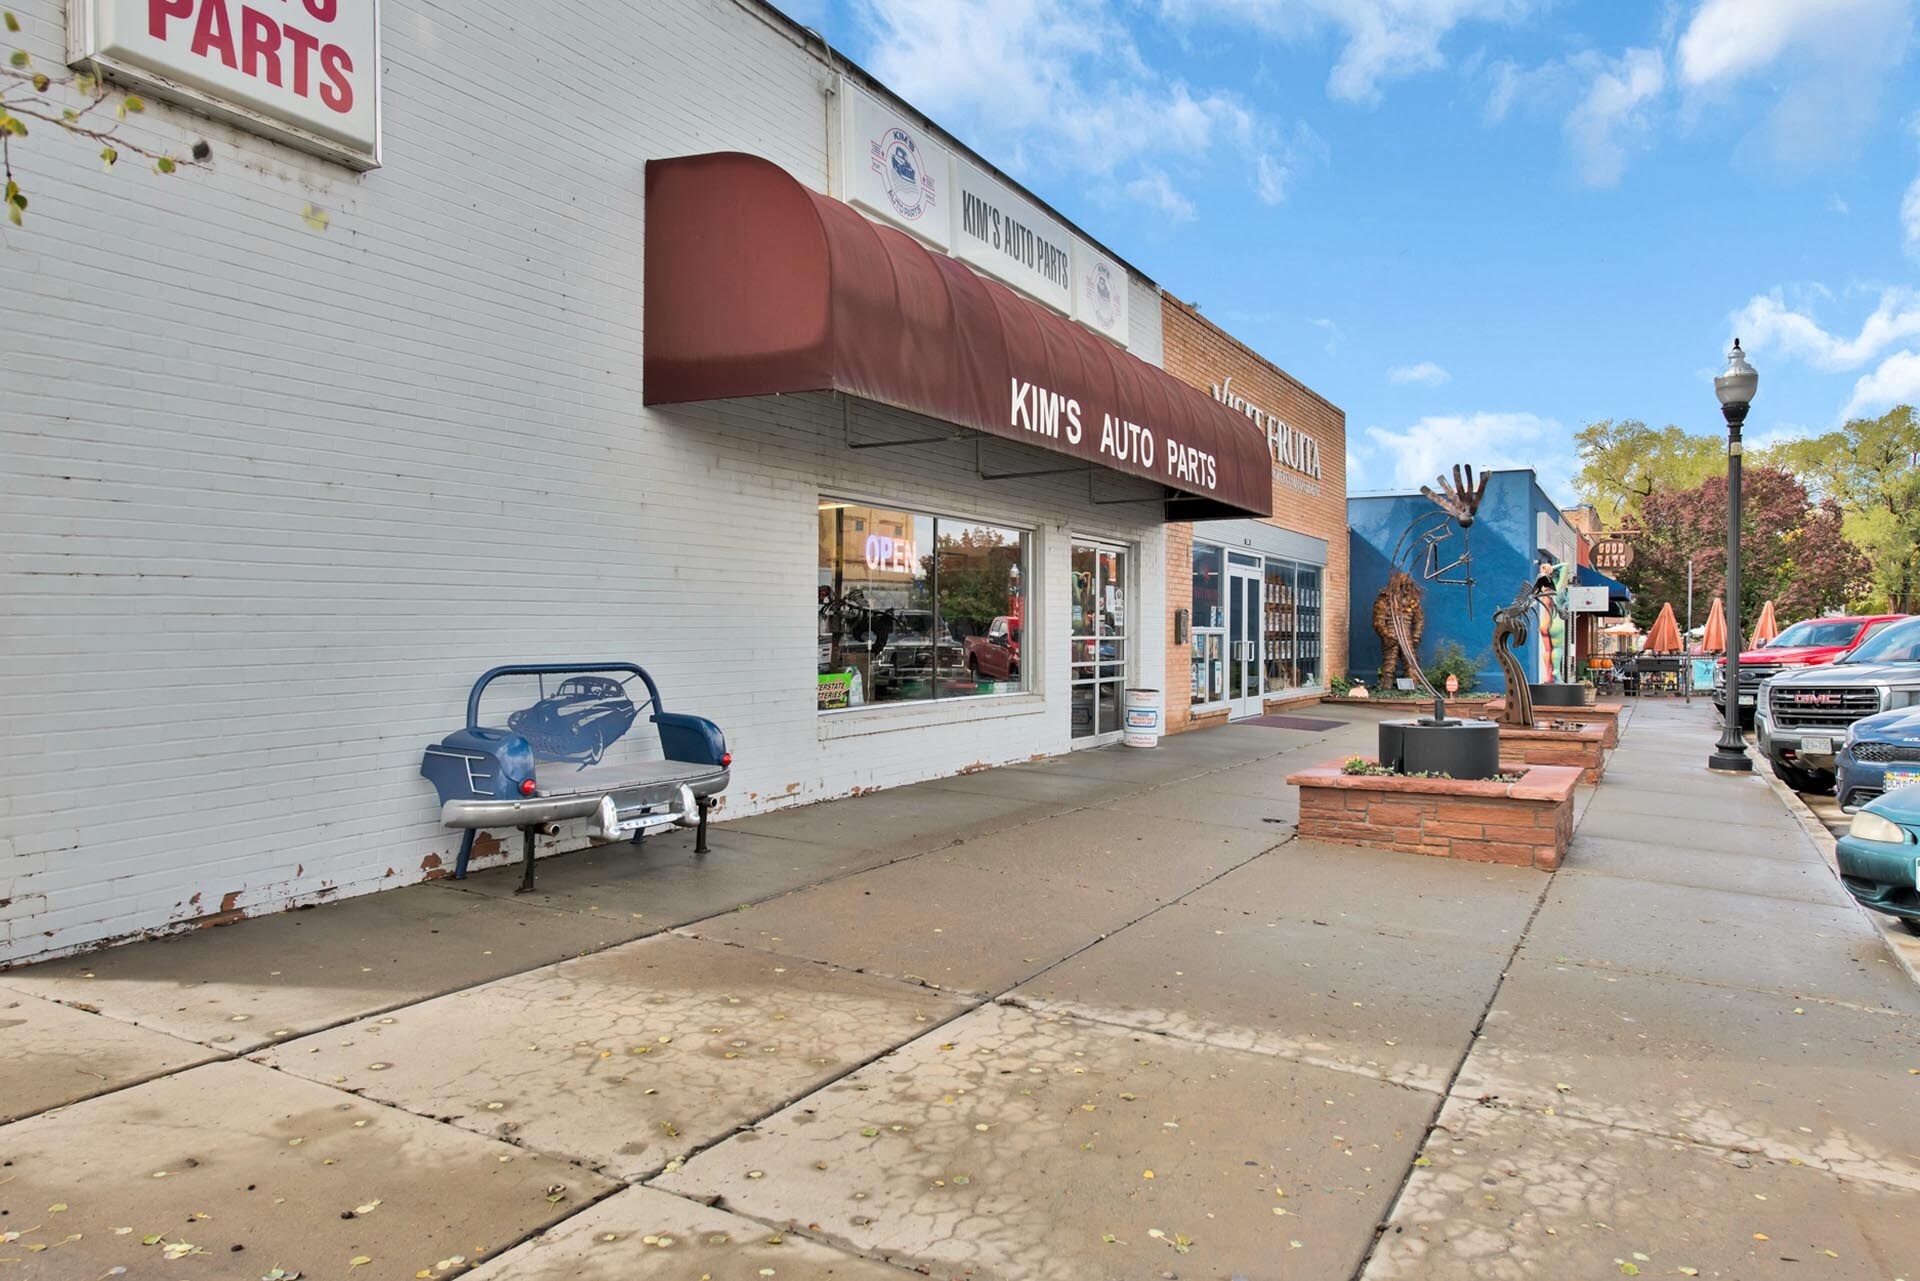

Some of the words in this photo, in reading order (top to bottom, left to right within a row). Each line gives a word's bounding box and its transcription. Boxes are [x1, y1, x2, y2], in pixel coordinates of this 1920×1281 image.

[962, 189, 1000, 250] KIM'S
[1004, 215, 1033, 270] AUTO
[1037, 235, 1069, 290] PARTS
[1011, 377, 1082, 444] KIM'S
[1100, 412, 1154, 468] AUTO
[1167, 438, 1216, 490] PARTS
[1266, 413, 1321, 480] FRUITA
[865, 534, 917, 574] OPEN
[1596, 554, 1626, 567] EATS
[1598, 542, 1624, 554] GOOD
[1793, 694, 1841, 704] GMC
